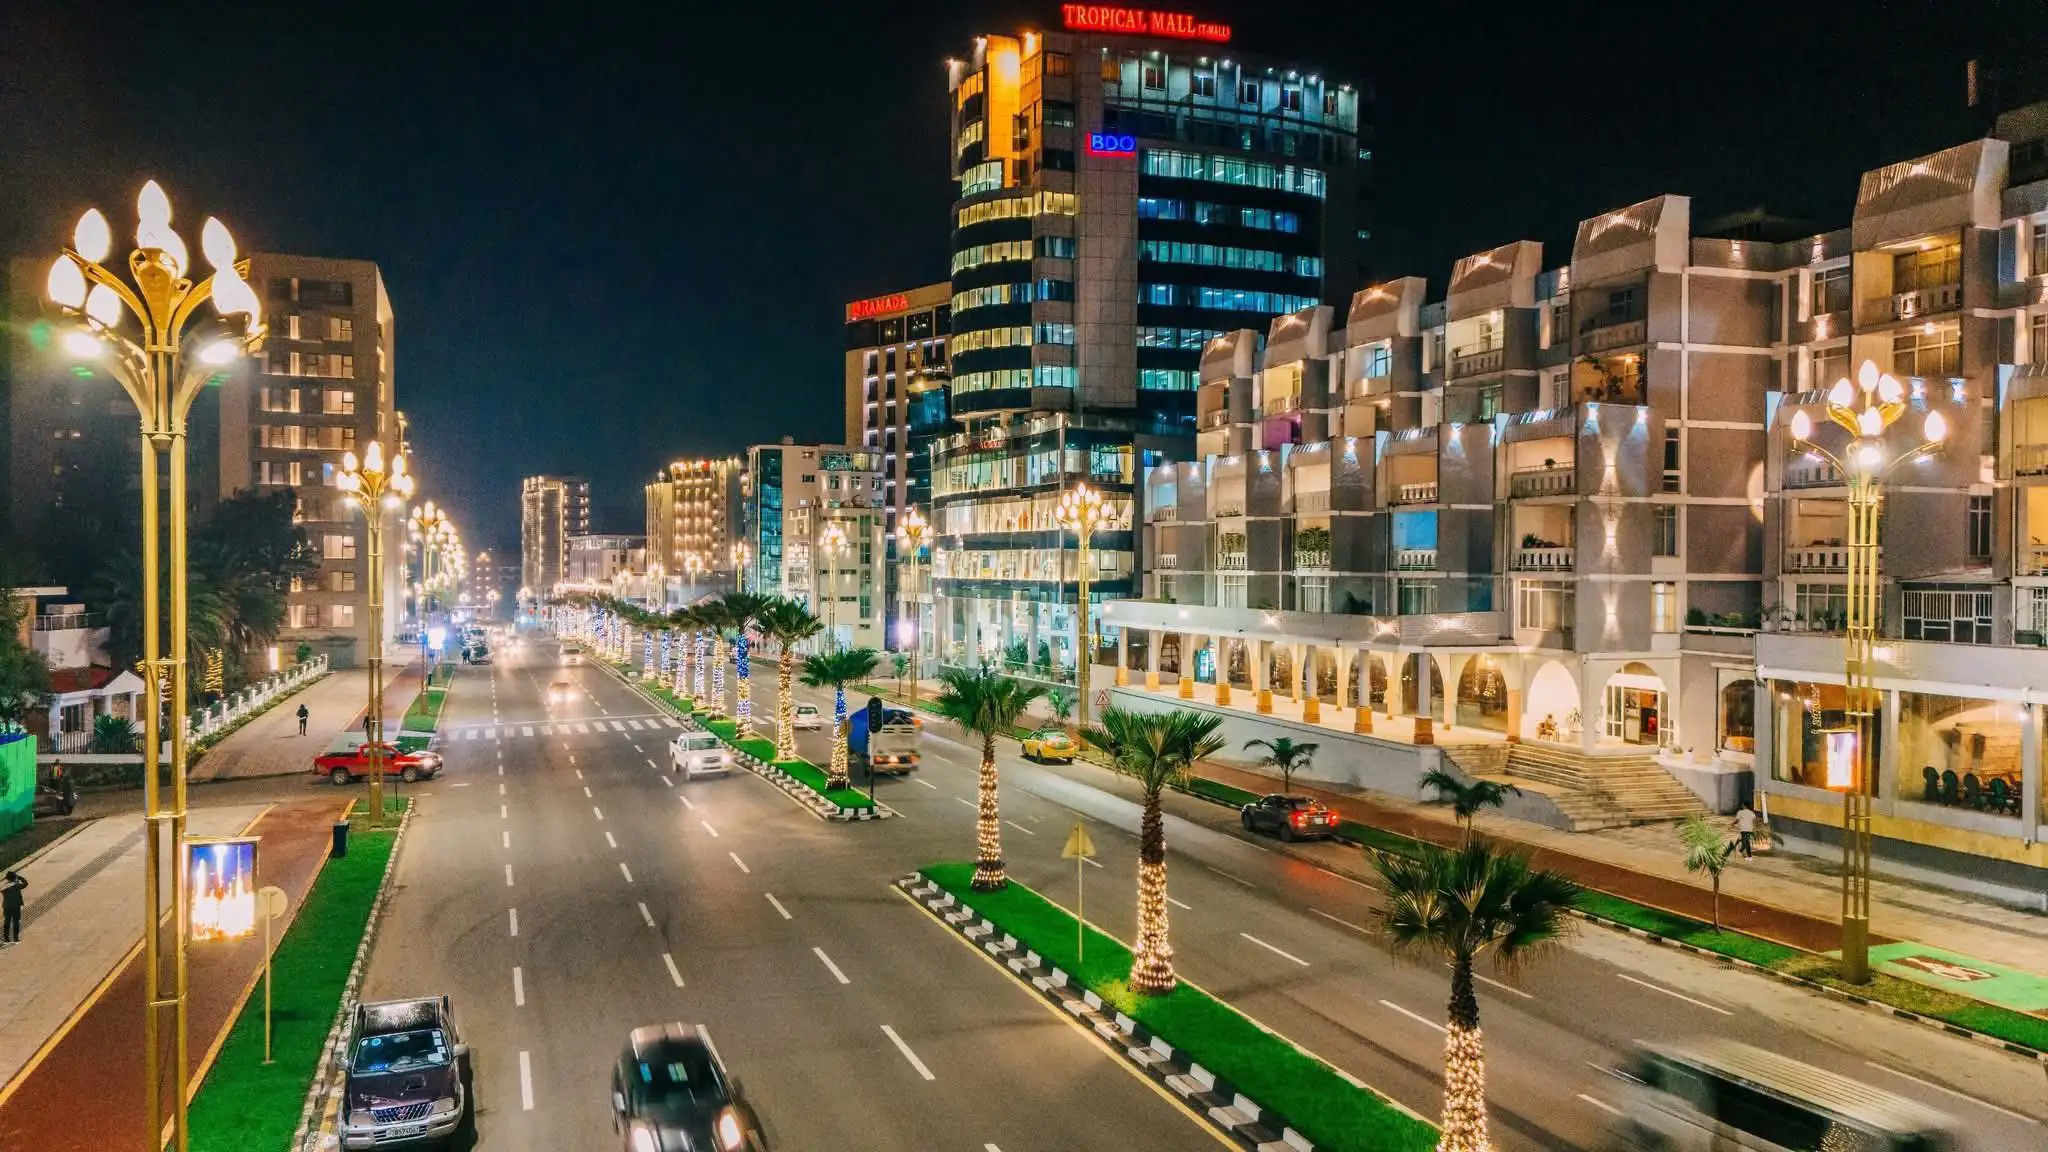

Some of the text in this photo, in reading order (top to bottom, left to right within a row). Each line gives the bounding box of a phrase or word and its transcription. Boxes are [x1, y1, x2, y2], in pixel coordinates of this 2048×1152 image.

[1064, 4, 1147, 28] TROPICAL
[1151, 12, 1196, 33] MALL
[1092, 135, 1135, 151] BDO
[862, 295, 908, 315] RAMADA
